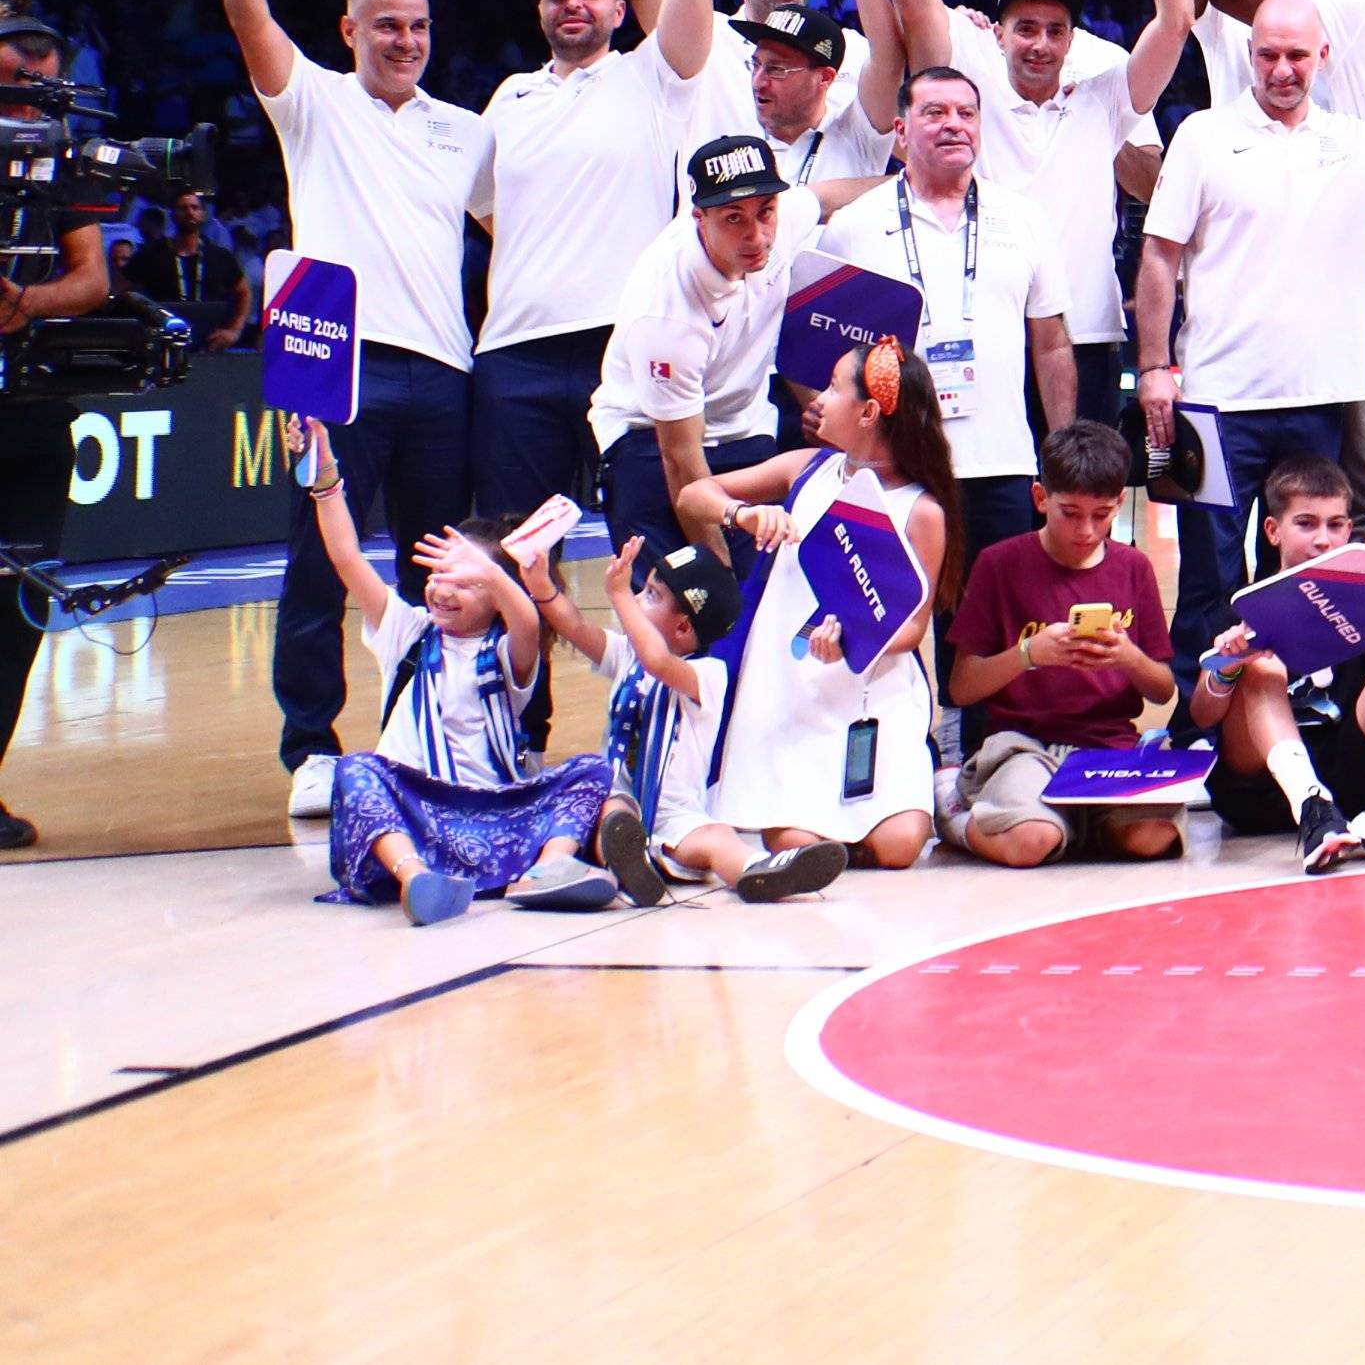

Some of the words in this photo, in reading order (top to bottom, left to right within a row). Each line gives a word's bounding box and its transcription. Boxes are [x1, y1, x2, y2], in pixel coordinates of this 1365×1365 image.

[269, 308, 312, 332] PARIS
[313, 317, 349, 341] 2024
[809, 313, 836, 331] ET
[838, 323, 890, 346] VOIL
[284, 335, 332, 361] BOUND
[834, 522, 853, 554] EN
[849, 553, 887, 623] ROUTE
[1298, 580, 1362, 645] QUALIFIED
